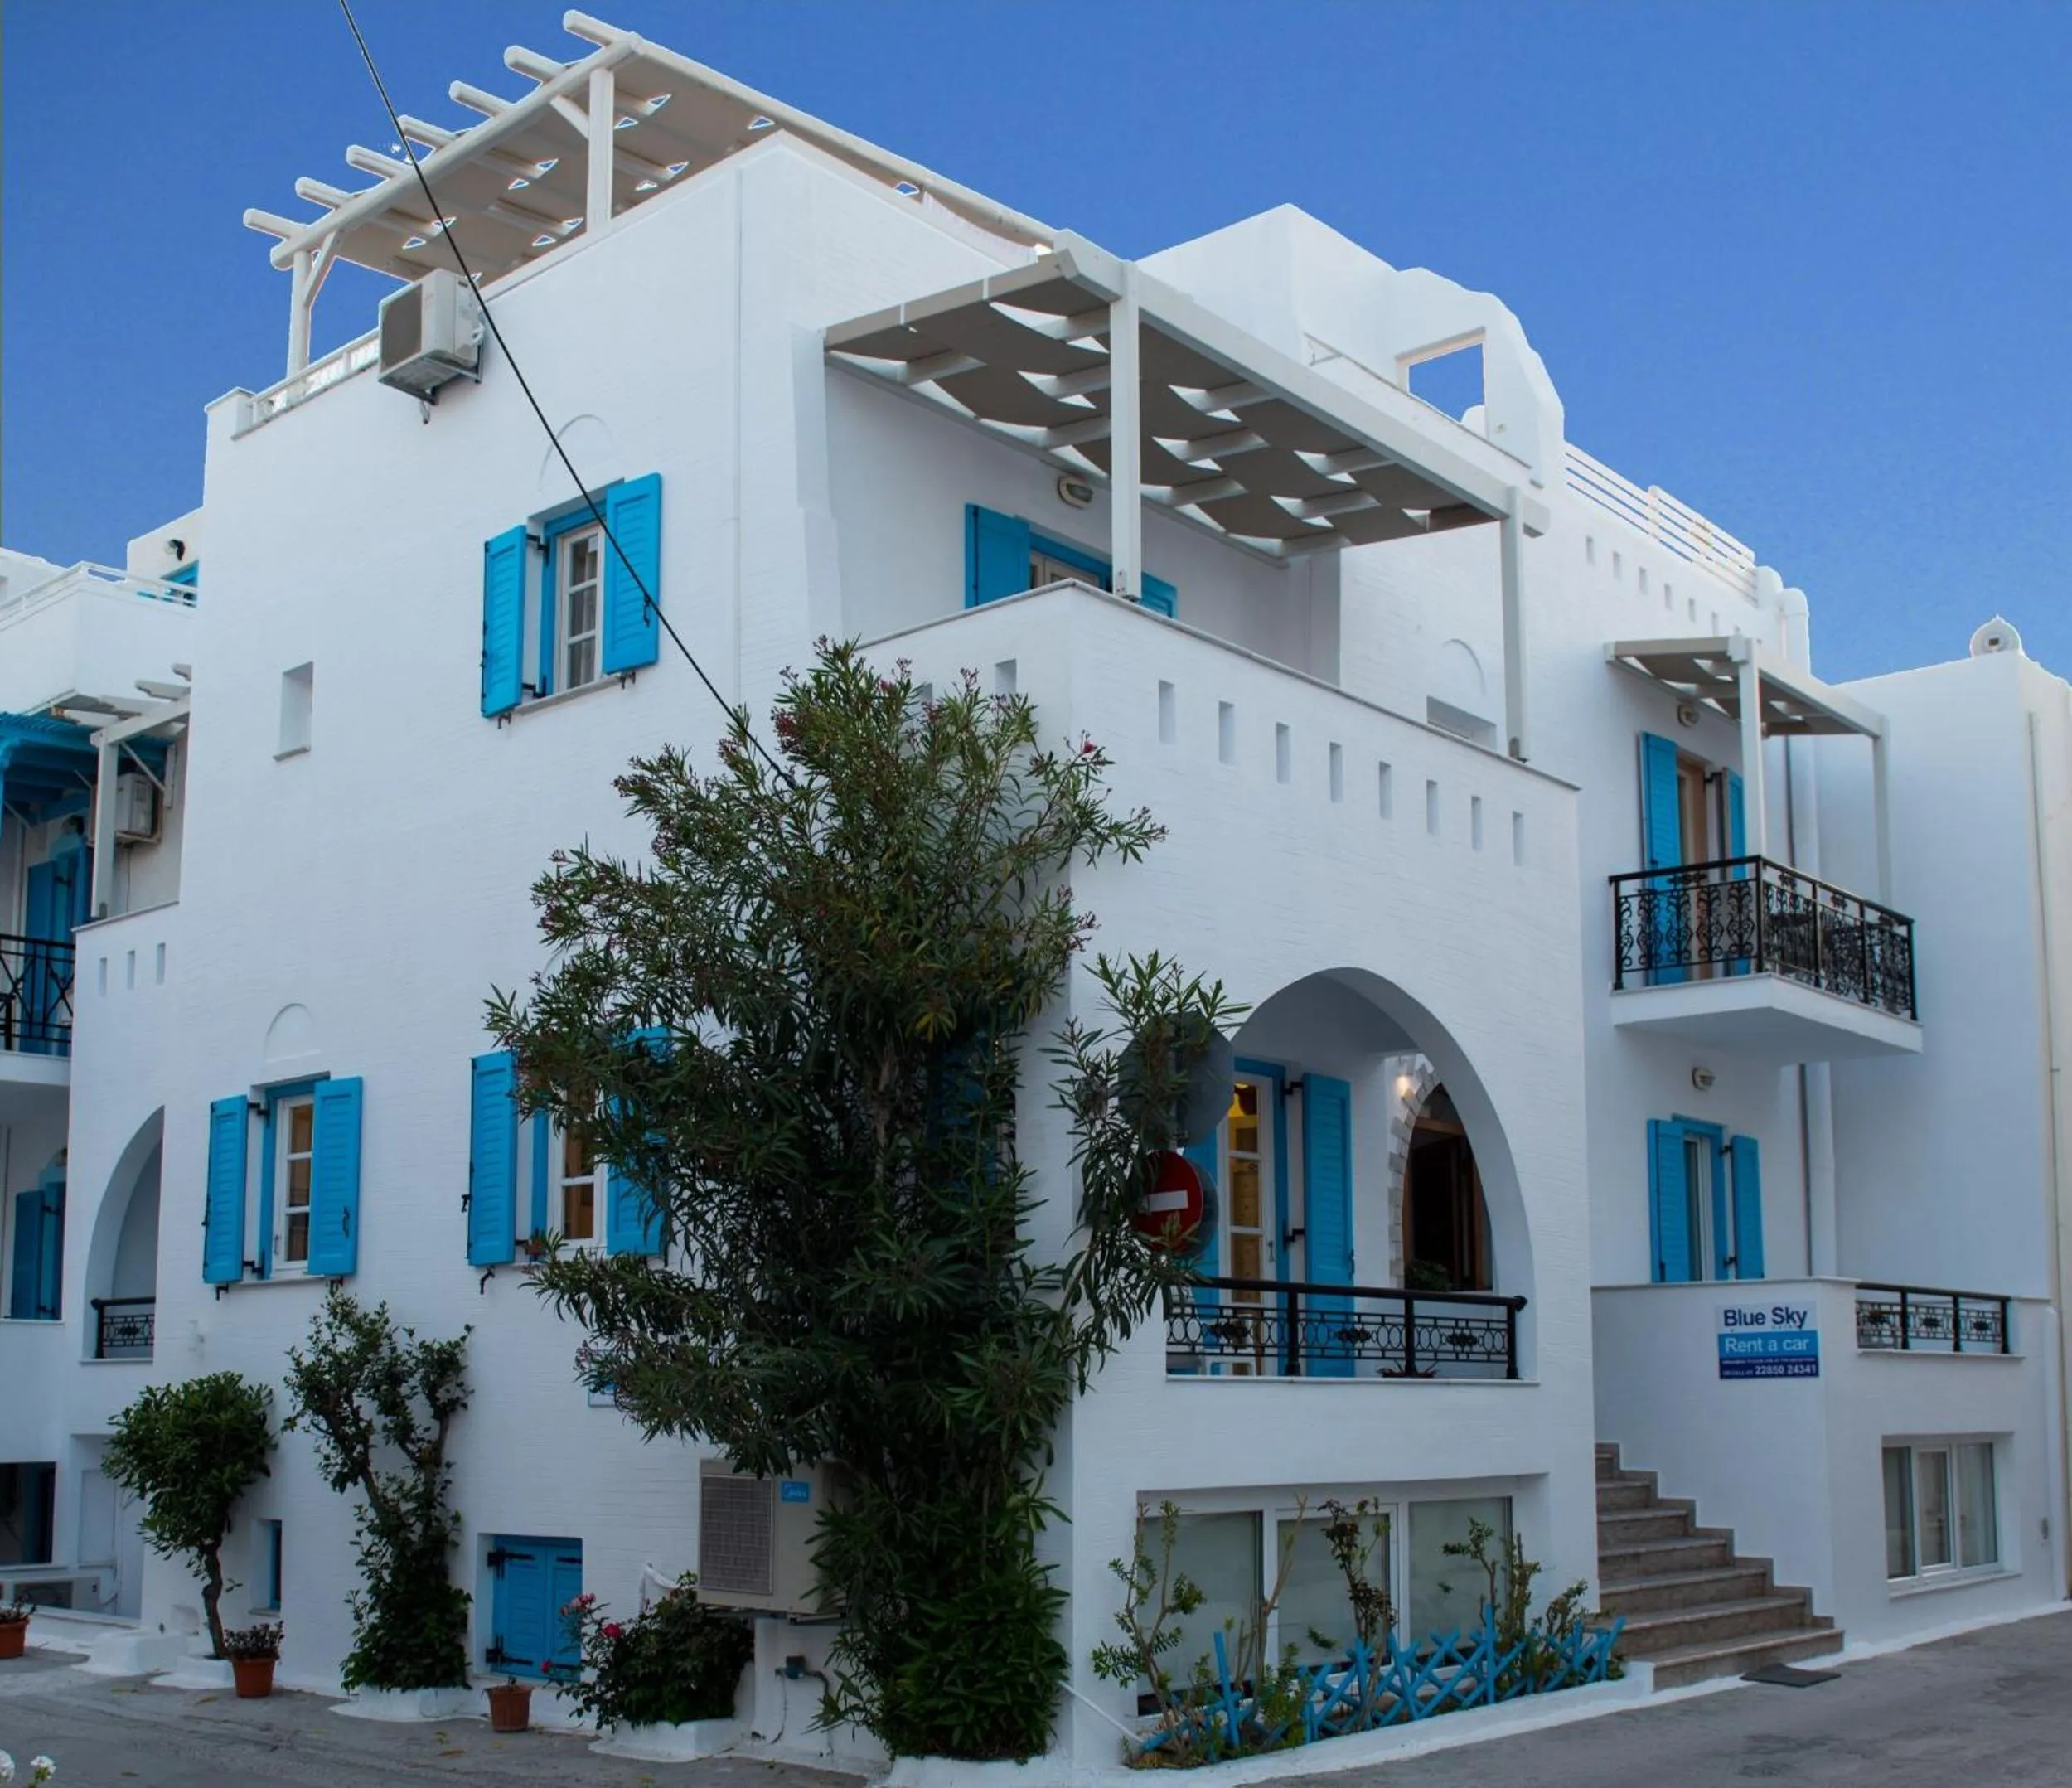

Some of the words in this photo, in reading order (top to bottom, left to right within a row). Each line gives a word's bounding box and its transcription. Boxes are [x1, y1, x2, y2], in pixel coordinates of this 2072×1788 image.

[1724, 1308, 1765, 1327] Blue
[1771, 1306, 1808, 1330] Sky
[1725, 1337, 1764, 1353] Rent
[1768, 1339, 1778, 1352] a
[1783, 1338, 1810, 1352] car
